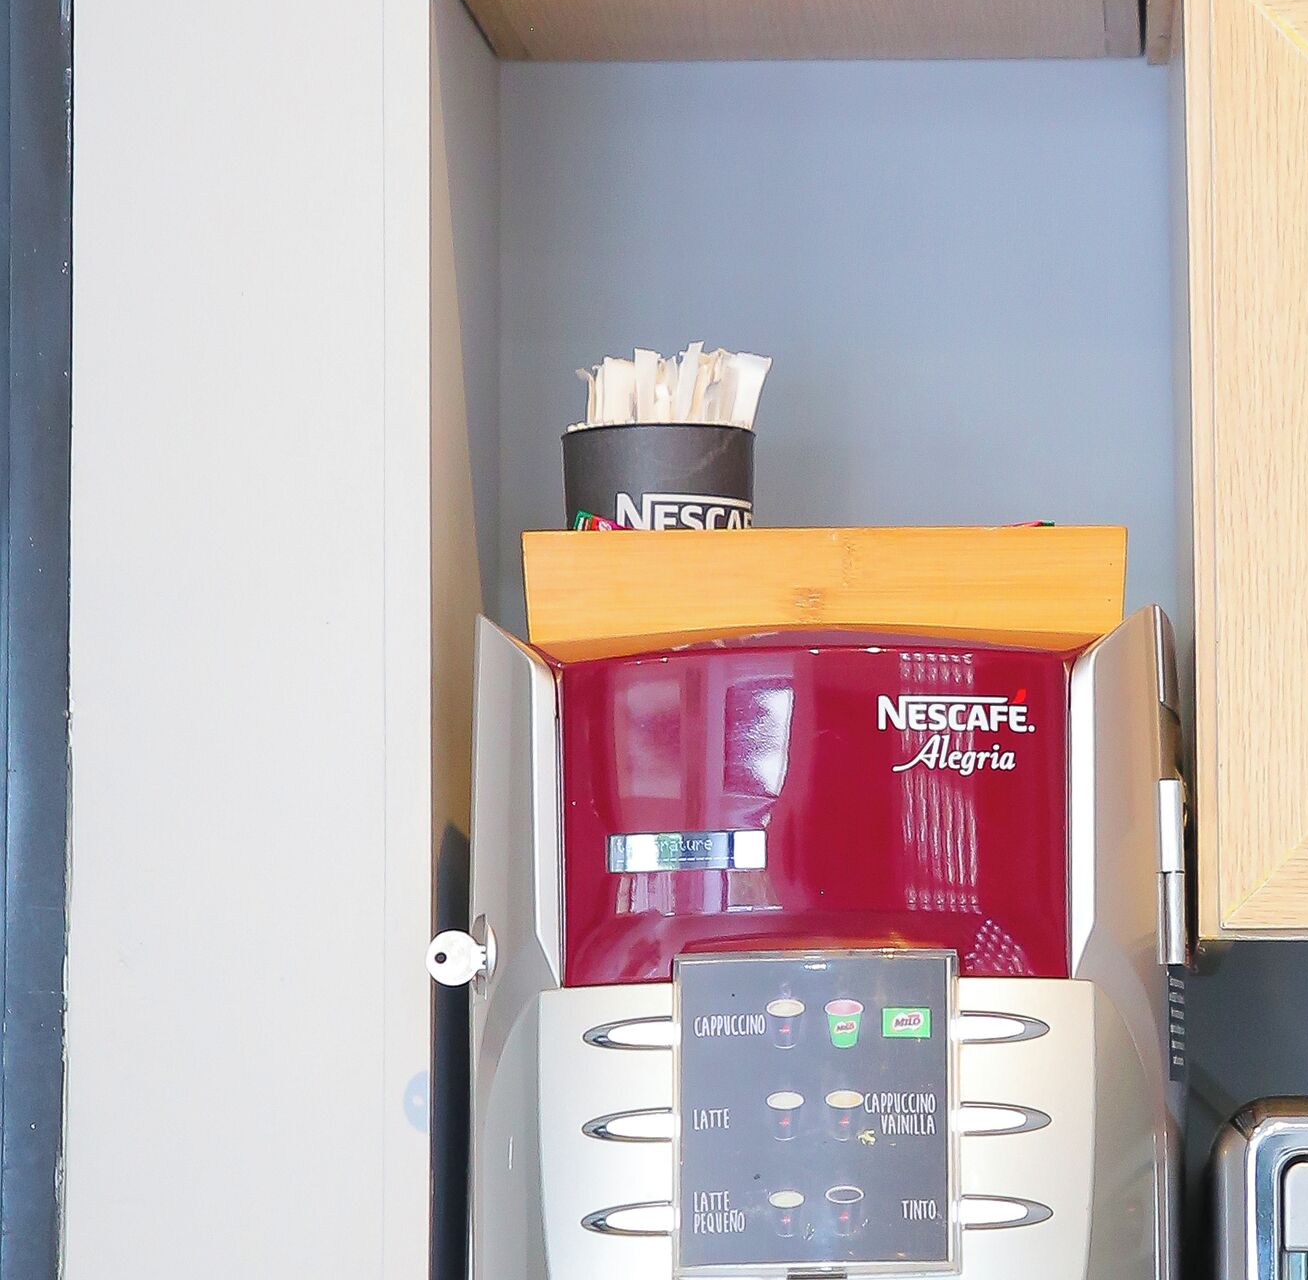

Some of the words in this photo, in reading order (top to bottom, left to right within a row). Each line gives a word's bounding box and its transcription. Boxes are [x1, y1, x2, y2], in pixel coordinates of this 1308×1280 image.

[694, 1014, 766, 1037] CAPPUCCINO
[893, 1017, 921, 1028] MILO
[865, 1093, 936, 1114] CAPPUCCINO
[694, 1108, 729, 1130] LATTE
[881, 1113, 935, 1135] VAINILLA
[694, 1191, 729, 1212] LATTE
[901, 1200, 936, 1219] TINTO
[694, 1208, 745, 1234] PEQUEÑO
